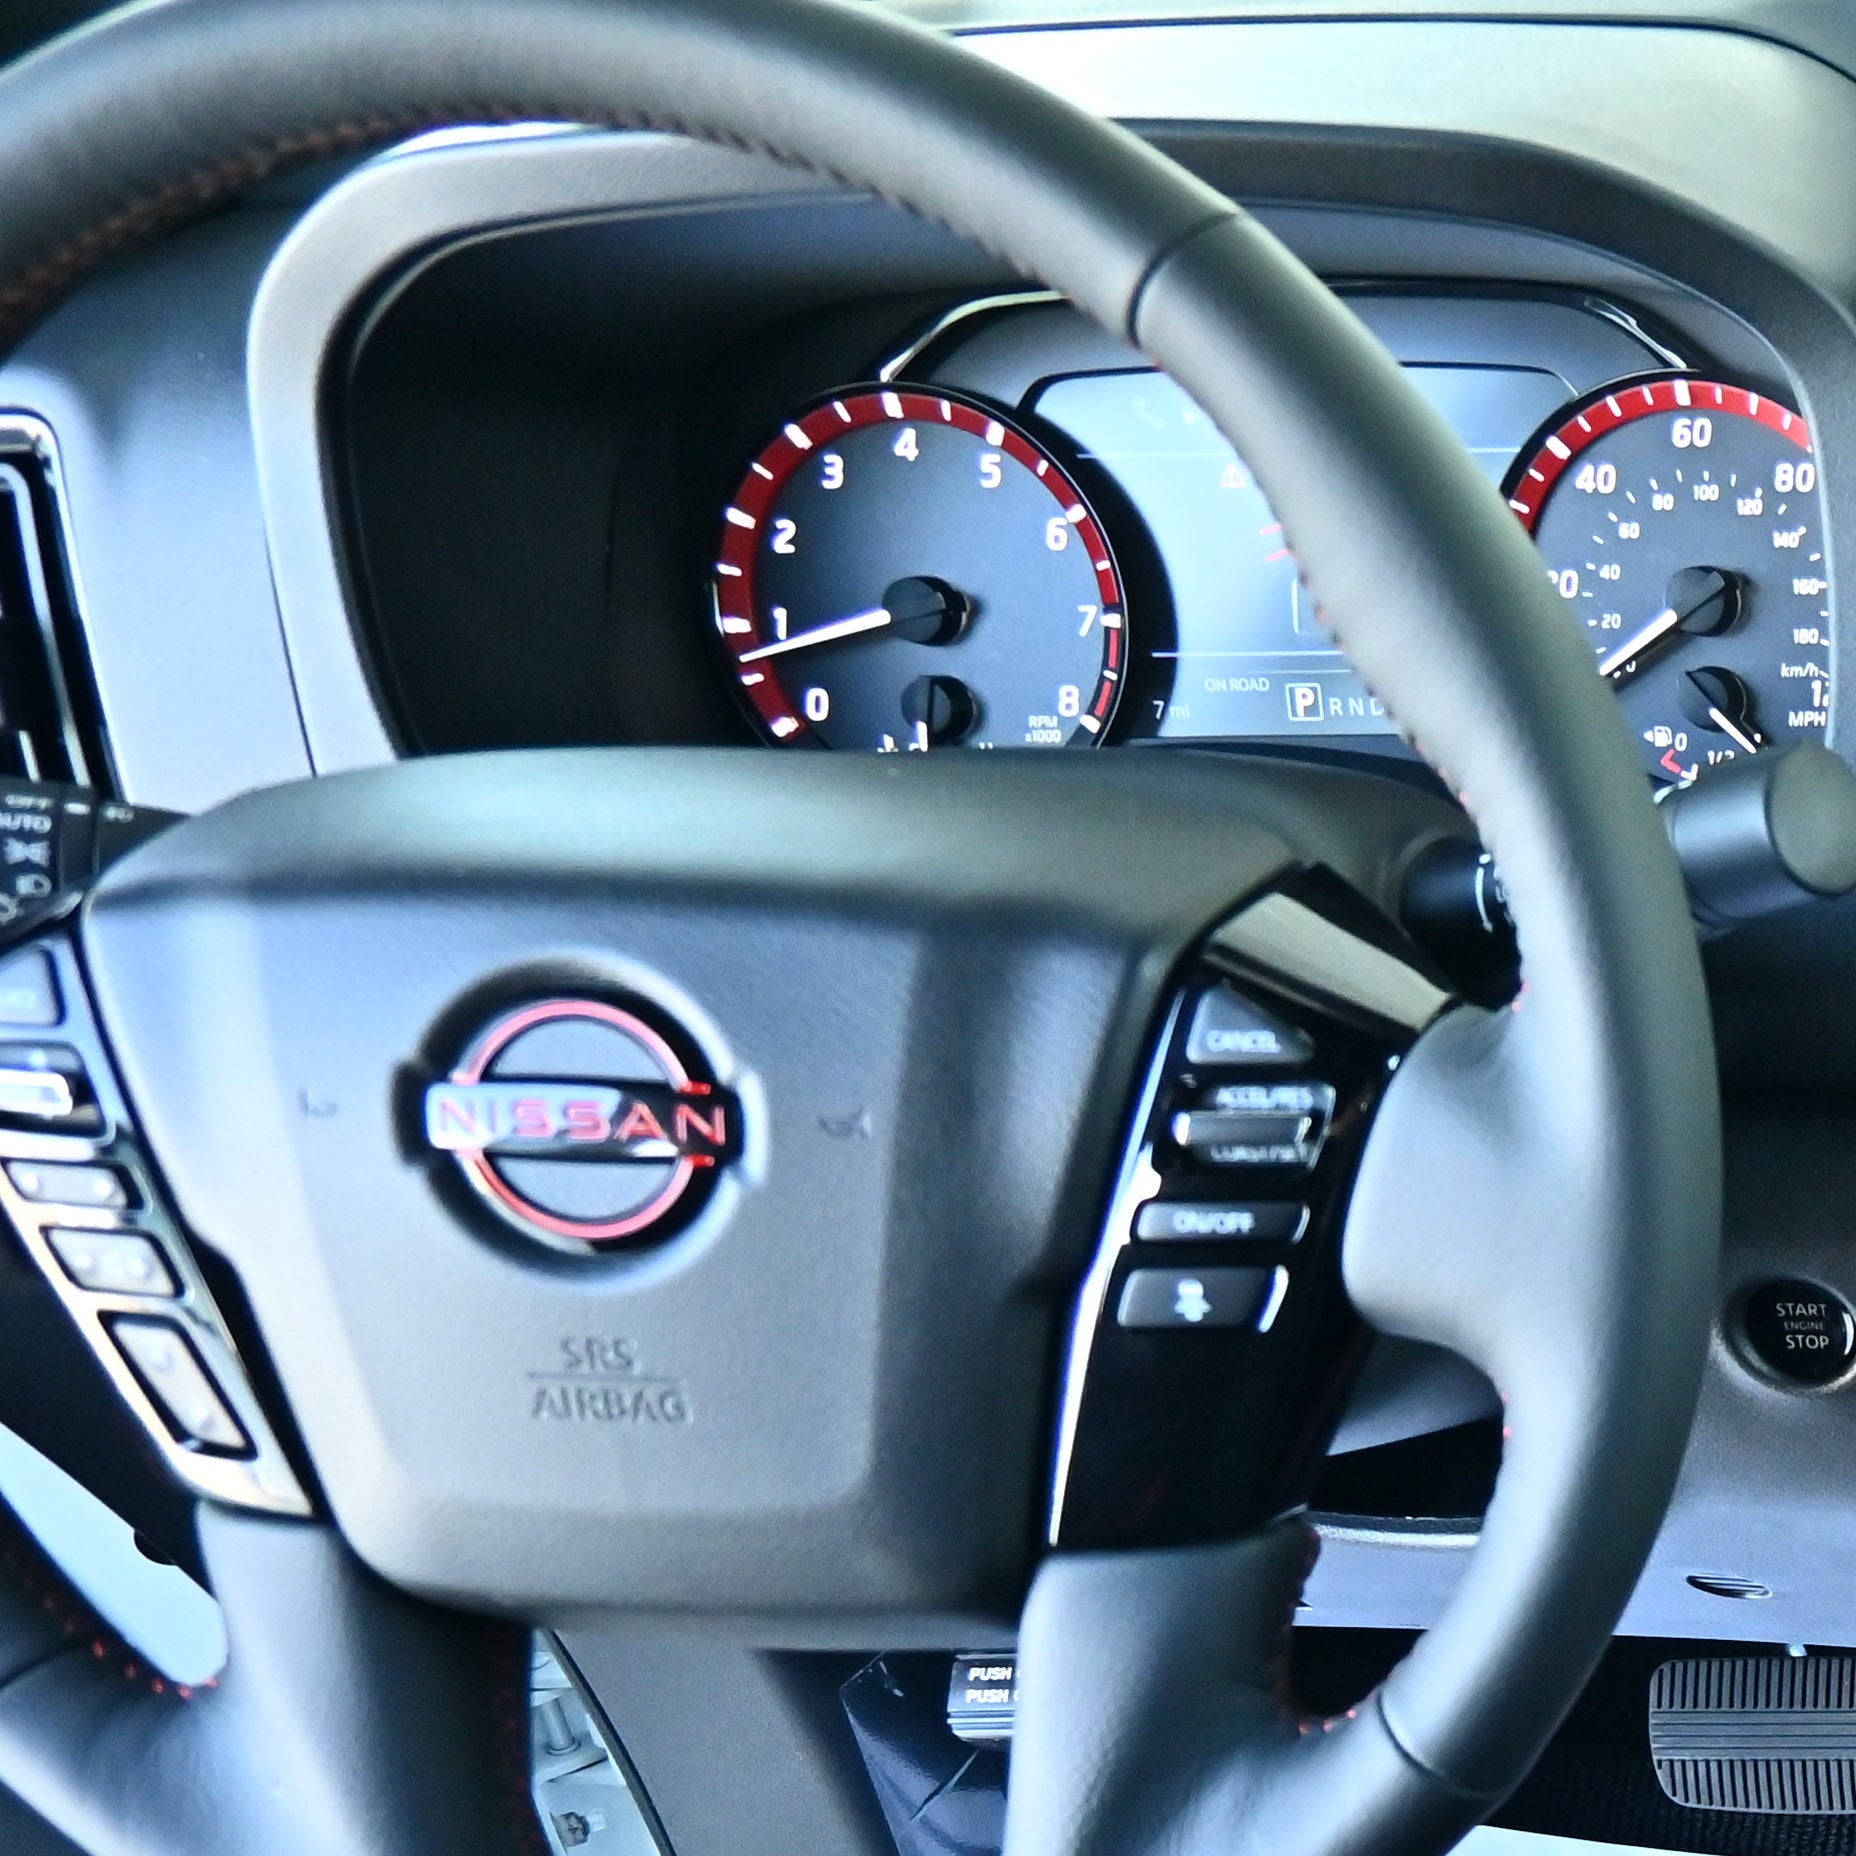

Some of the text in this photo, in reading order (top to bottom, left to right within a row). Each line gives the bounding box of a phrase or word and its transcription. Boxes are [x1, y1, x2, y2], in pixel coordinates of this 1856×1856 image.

[1672, 419, 1711, 447] 60
[894, 429, 918, 459] 4
[822, 455, 843, 489] 3
[980, 455, 1000, 488] 5
[1576, 465, 1616, 493] 40
[1775, 464, 1815, 493] 80
[1694, 485, 1719, 501] 100
[1653, 494, 1673, 510] 80
[1738, 499, 1762, 516] 120
[772, 520, 796, 553] 2
[1046, 518, 1067, 551] 6
[1774, 532, 1798, 548] 140
[1600, 565, 1620, 580] 40
[1793, 580, 1817, 595] 160
[774, 607, 787, 640] 1
[1078, 605, 1097, 637] 7
[1602, 615, 1621, 629] 20
[1794, 629, 1818, 644] 180
[1781, 663, 1819, 678] km/h
[1204, 678, 1270, 691] ON ROAD
[806, 688, 829, 721] 0
[1059, 686, 1079, 716] 8
[1294, 687, 1315, 717] P
[1330, 698, 1364, 716] R N
[1029, 716, 1057, 728] RPM
[1789, 712, 1826, 727] MPH
[1025, 730, 1061, 743] x1000
[1207, 1030, 1281, 1053] CANCEL
[438, 1099, 725, 1145] NISSAN
[1776, 1303, 1826, 1317] START
[1784, 1321, 1825, 1331] ENGINE
[1786, 1335, 1830, 1349] STOP
[559, 1338, 635, 1373] SRS
[530, 1388, 690, 1424] AIRBAG
[968, 1667, 1012, 1681] PUSH
[966, 1689, 1008, 1703] PUSH
